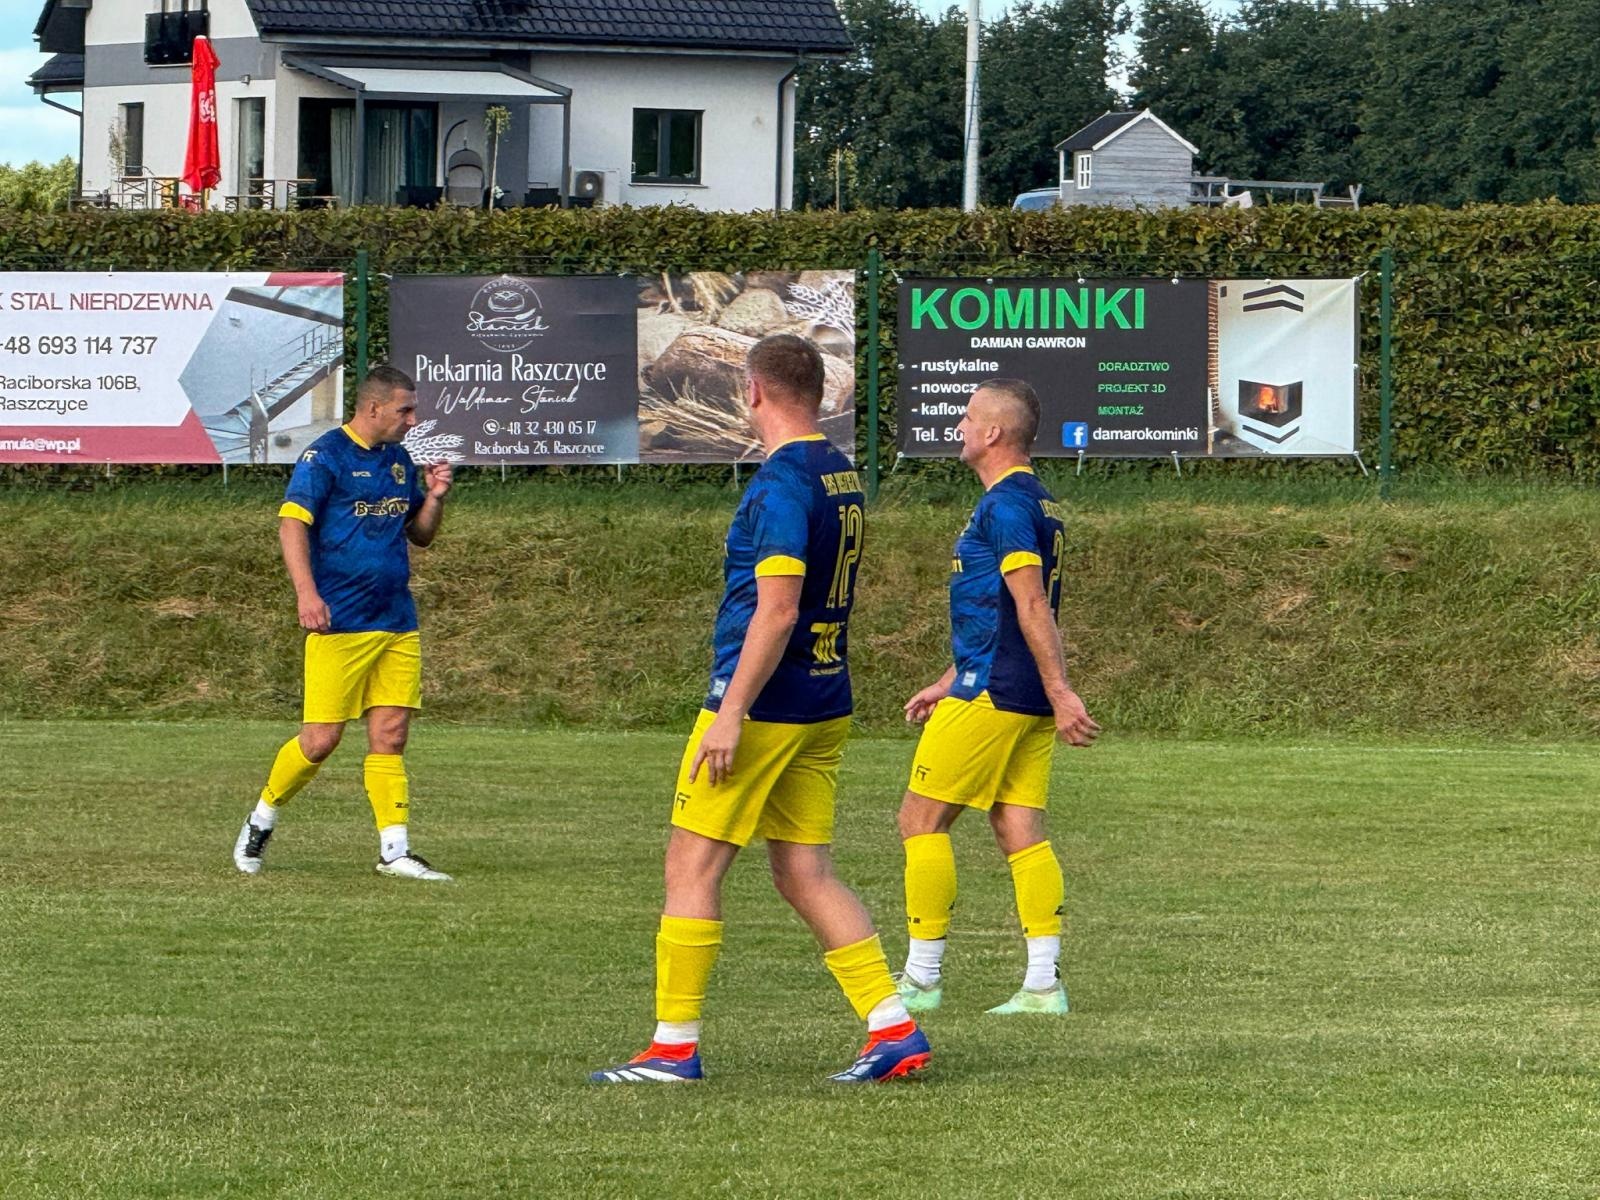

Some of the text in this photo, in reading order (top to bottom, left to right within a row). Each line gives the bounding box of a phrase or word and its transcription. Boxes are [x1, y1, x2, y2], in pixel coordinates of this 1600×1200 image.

[10, 292, 63, 310] STAL
[70, 292, 214, 311] NIERDZEWNA
[911, 287, 1146, 331] KOMINKI
[38, 335, 77, 355] 693
[84, 336, 113, 354] 114
[119, 336, 158, 355] 737
[970, 336, 1087, 349] DAMIAN GAWRON
[416, 354, 607, 387] Piekarnia Raszczyce
[921, 359, 999, 374] rustykalne
[1098, 361, 1170, 372] DORADZTWO
[0, 375, 141, 393] Raciborska 106B,
[1098, 383, 1167, 393] PROJEKT 3D
[0, 396, 89, 415] Raszczyce
[1098, 404, 1144, 415] MONTAŻ
[524, 421, 540, 435] 32
[568, 421, 583, 435] 05
[587, 420, 597, 434] 17
[911, 427, 938, 442] Tel.
[1092, 427, 1199, 442] damarokominki
[474, 440, 530, 455] Raciborska
[553, 440, 605, 457] Raszczyce
[826, 503, 864, 609] 12
